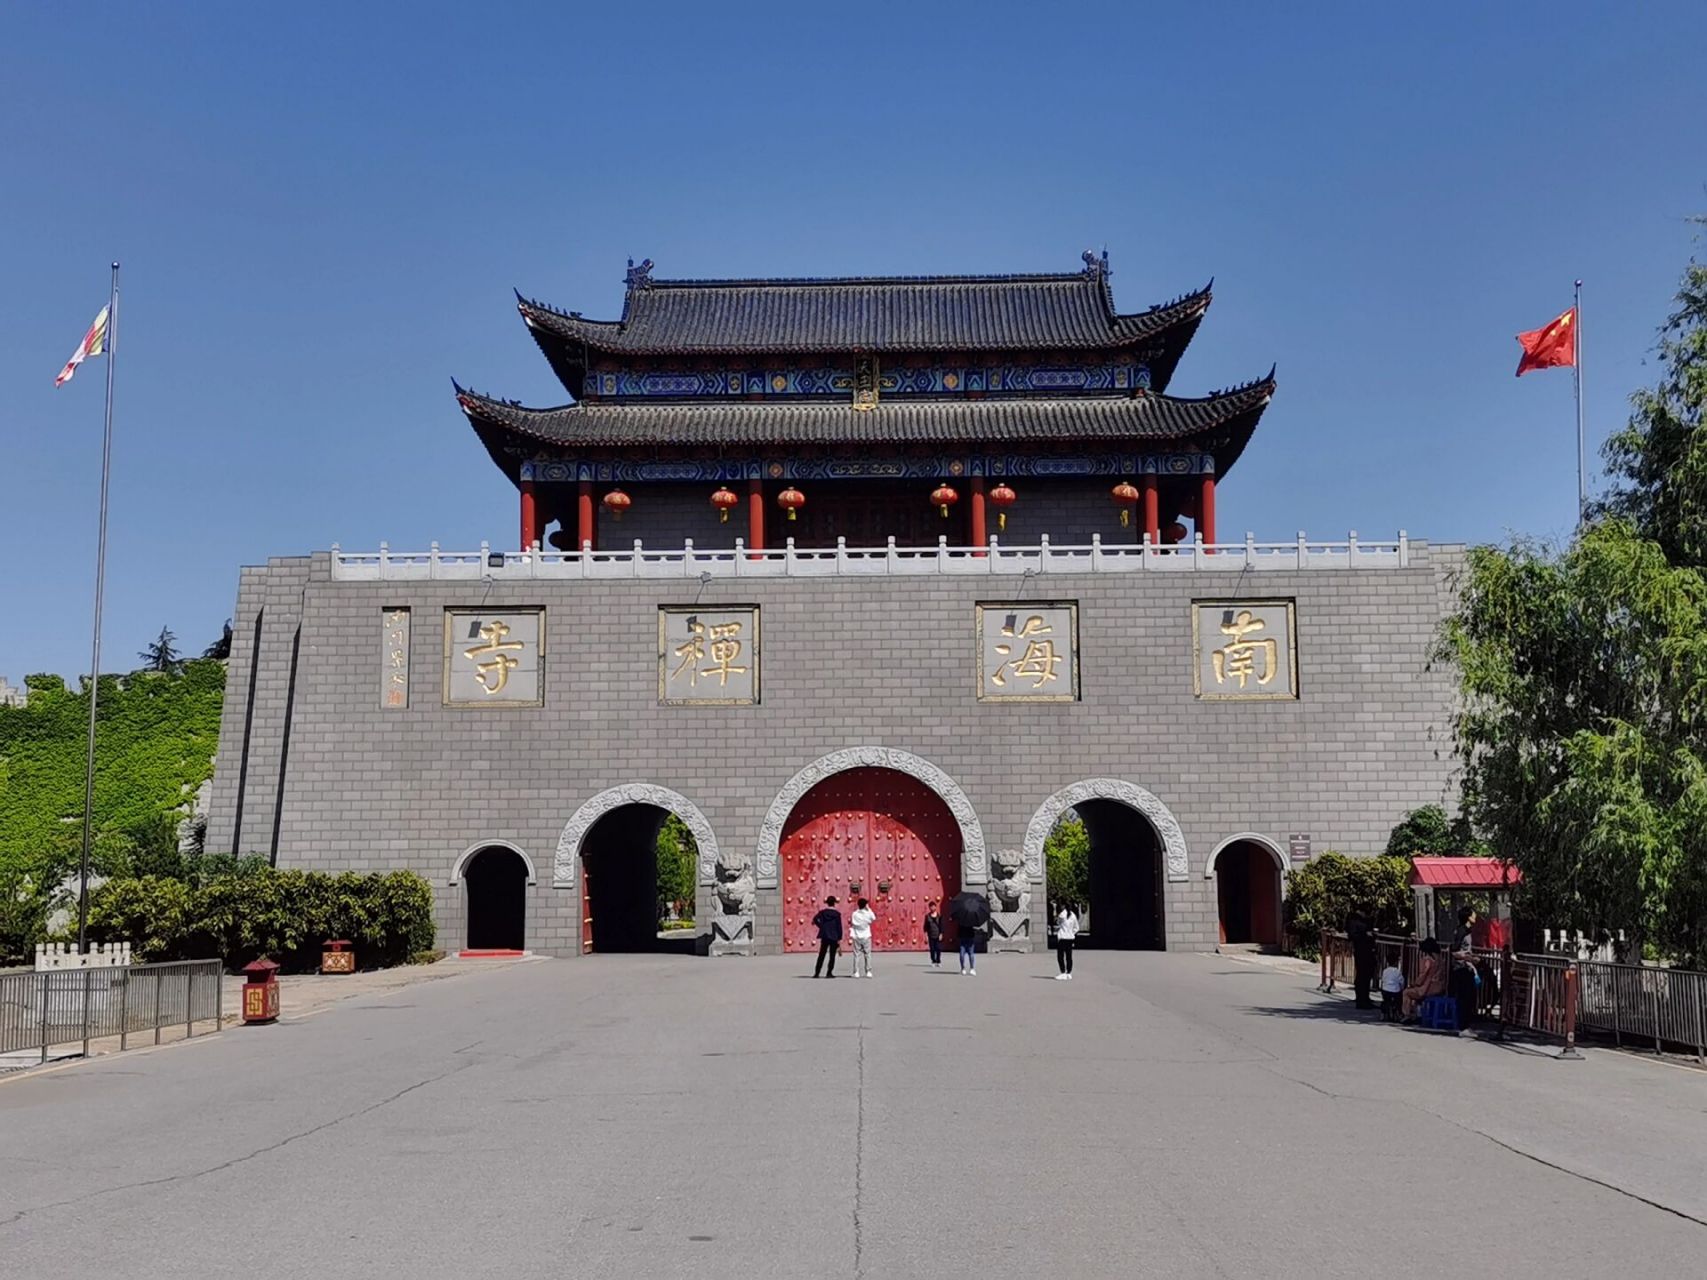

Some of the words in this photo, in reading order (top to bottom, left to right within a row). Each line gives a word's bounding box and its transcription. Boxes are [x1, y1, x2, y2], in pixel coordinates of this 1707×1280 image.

[463, 620, 524, 695] 寺
[991, 615, 1062, 689] 海
[1211, 610, 1279, 688] 南
